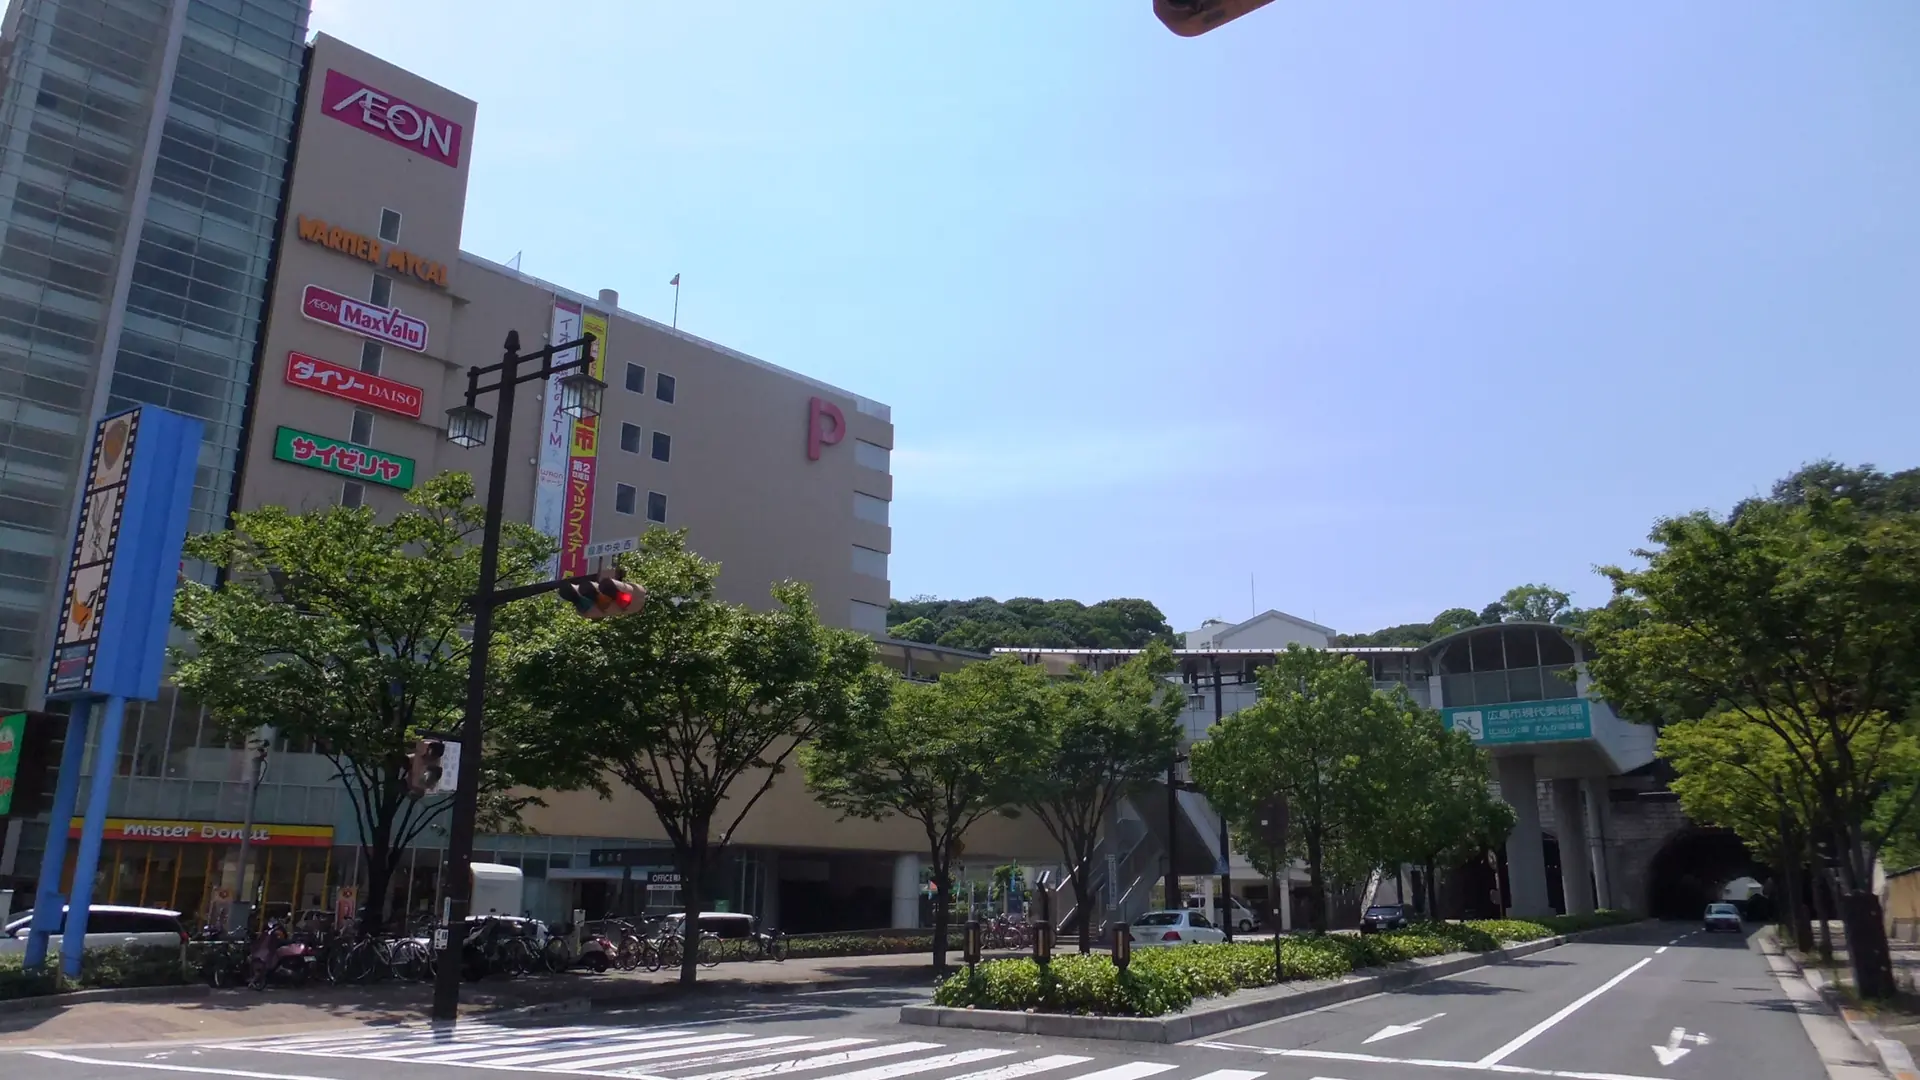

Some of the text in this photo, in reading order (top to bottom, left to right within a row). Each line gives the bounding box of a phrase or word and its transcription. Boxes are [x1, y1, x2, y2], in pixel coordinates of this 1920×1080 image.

[343, 304, 420, 344] MaxValu
[292, 361, 418, 408] ダイソー DAISO
[808, 396, 846, 461] P
[291, 436, 402, 481] サイゼリヤ
[652, 873, 673, 883] OFFICE
